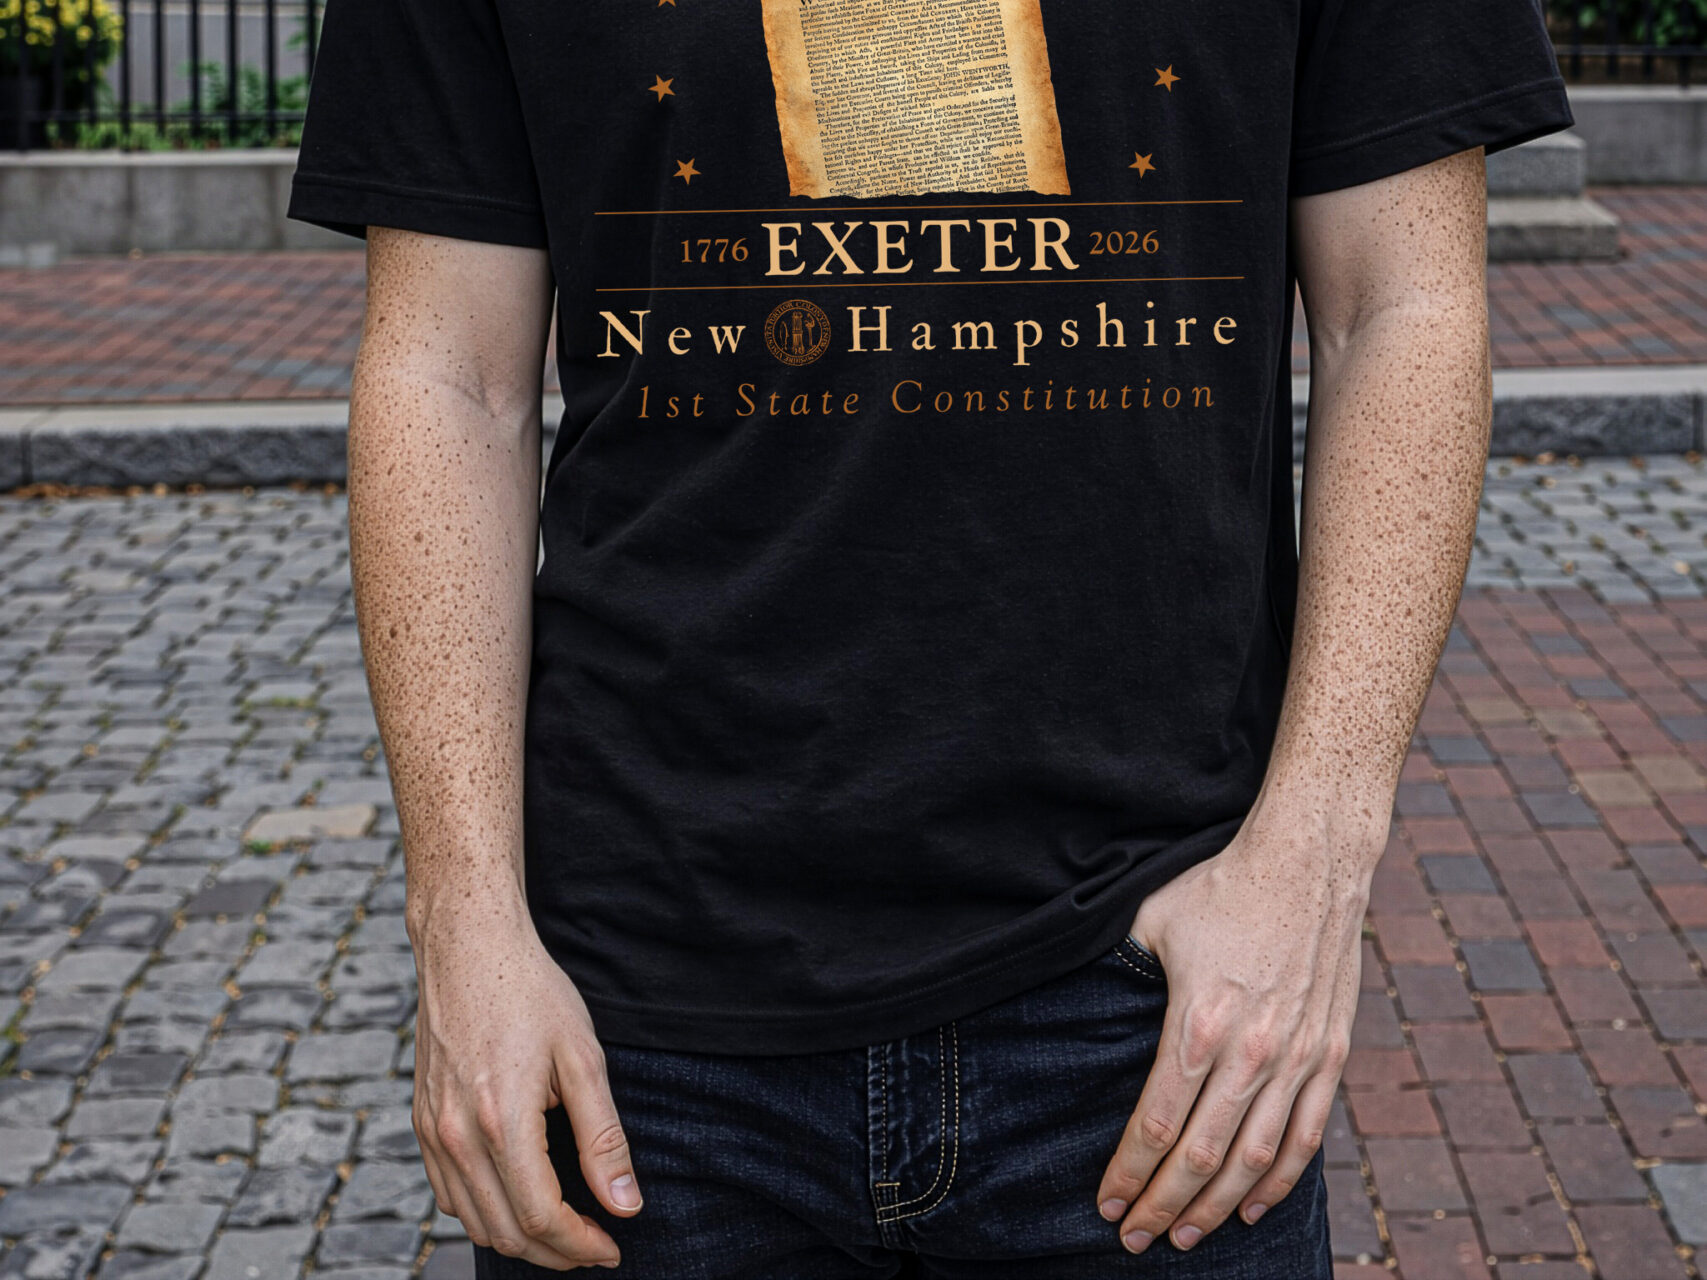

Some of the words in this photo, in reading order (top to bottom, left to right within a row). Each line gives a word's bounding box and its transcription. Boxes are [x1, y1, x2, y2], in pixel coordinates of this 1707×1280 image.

[682, 238, 748, 262] 1776
[761, 218, 1079, 276] EXETER
[1090, 230, 1159, 254] 2026
[597, 310, 746, 357] New
[847, 301, 1237, 366] Hampshire
[639, 386, 703, 417] 1st
[736, 384, 858, 416] State
[892, 378, 1214, 413] Constitution
